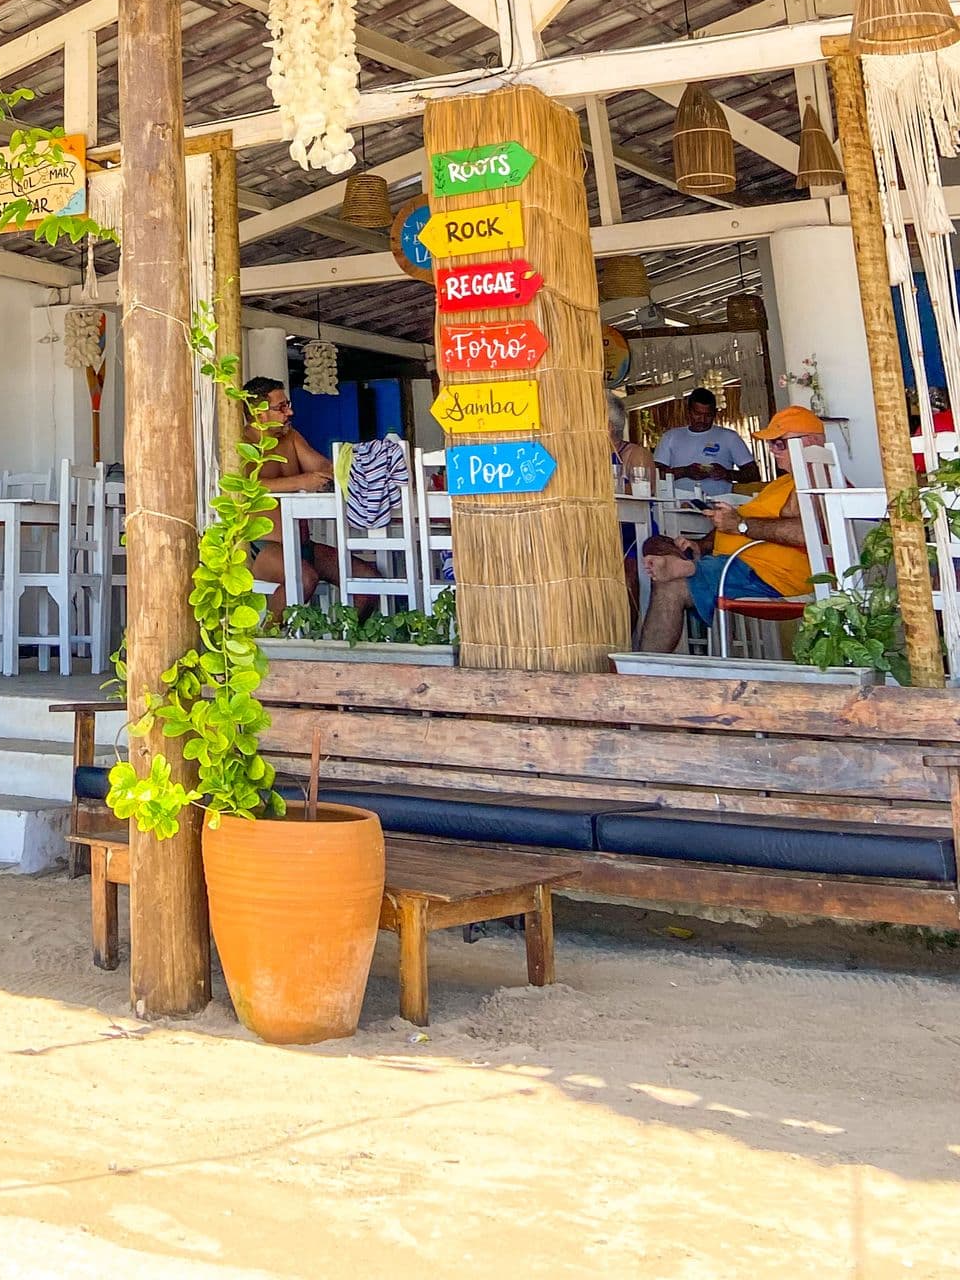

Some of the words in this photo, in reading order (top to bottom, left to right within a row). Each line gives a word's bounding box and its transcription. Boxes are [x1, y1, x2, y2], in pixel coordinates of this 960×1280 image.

[49, 167, 70, 181] MAR
[448, 154, 511, 183] ROOTS
[445, 216, 504, 243] ROCK
[445, 271, 517, 301] REGGAE
[451, 332, 527, 360] Forró
[440, 388, 529, 422] Samba
[469, 455, 514, 489] Pop
